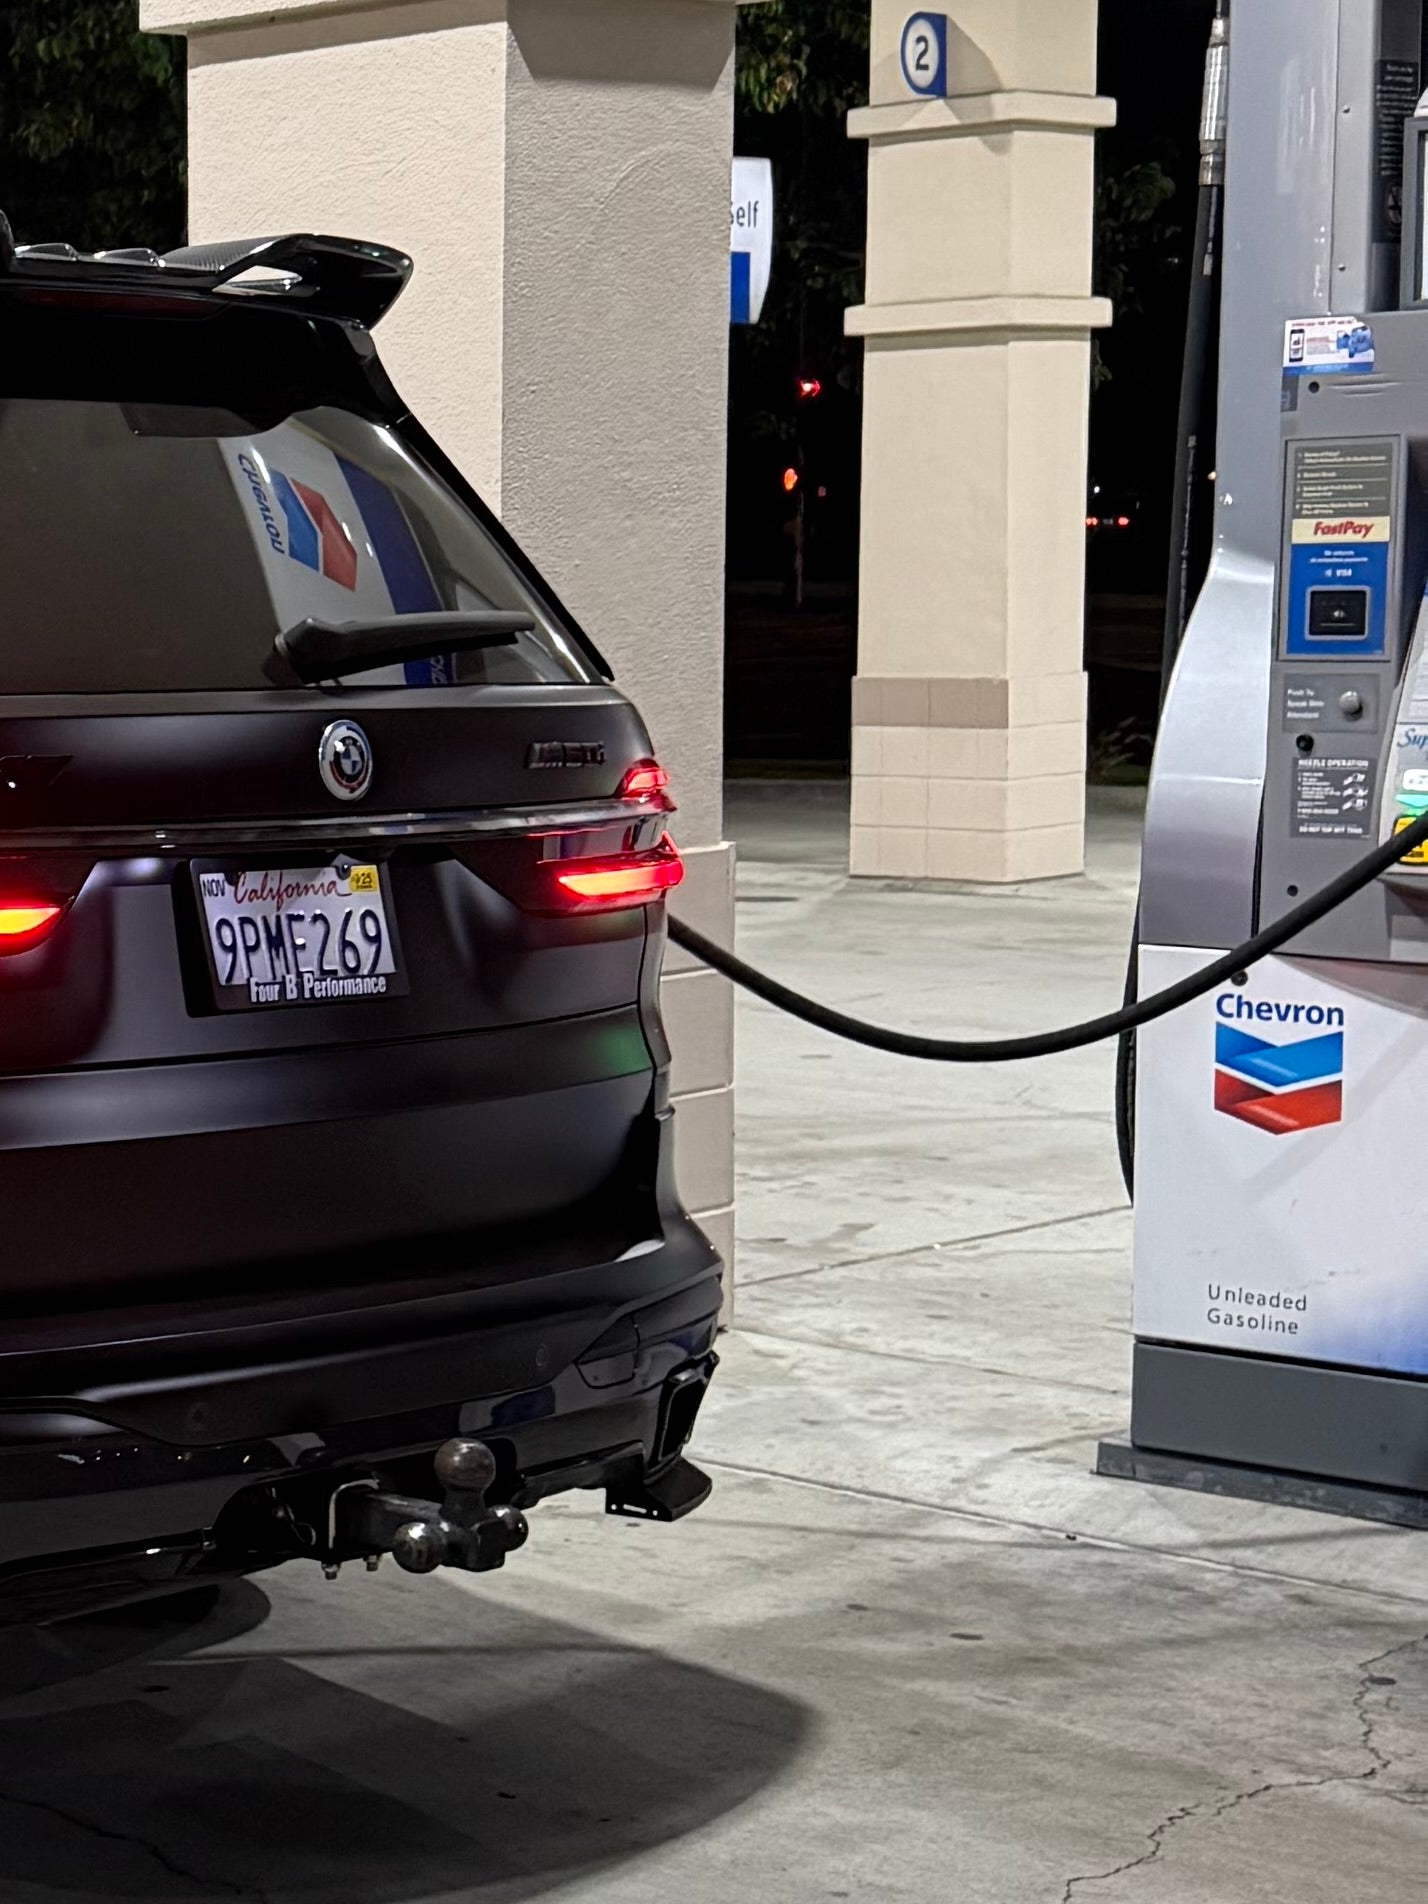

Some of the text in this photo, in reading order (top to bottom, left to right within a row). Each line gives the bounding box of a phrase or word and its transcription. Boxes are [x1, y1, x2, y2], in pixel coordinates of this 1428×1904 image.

[915, 34, 930, 71] 2
[728, 200, 760, 228] elf
[1313, 520, 1375, 539] FastPay
[202, 877, 226, 898] NOV
[232, 871, 353, 912] California
[249, 970, 387, 1003] Four B Performance
[1215, 992, 1345, 1027] Chevron
[1207, 1282, 1307, 1312] Unleaded
[1206, 1307, 1299, 1335] Gasoline
